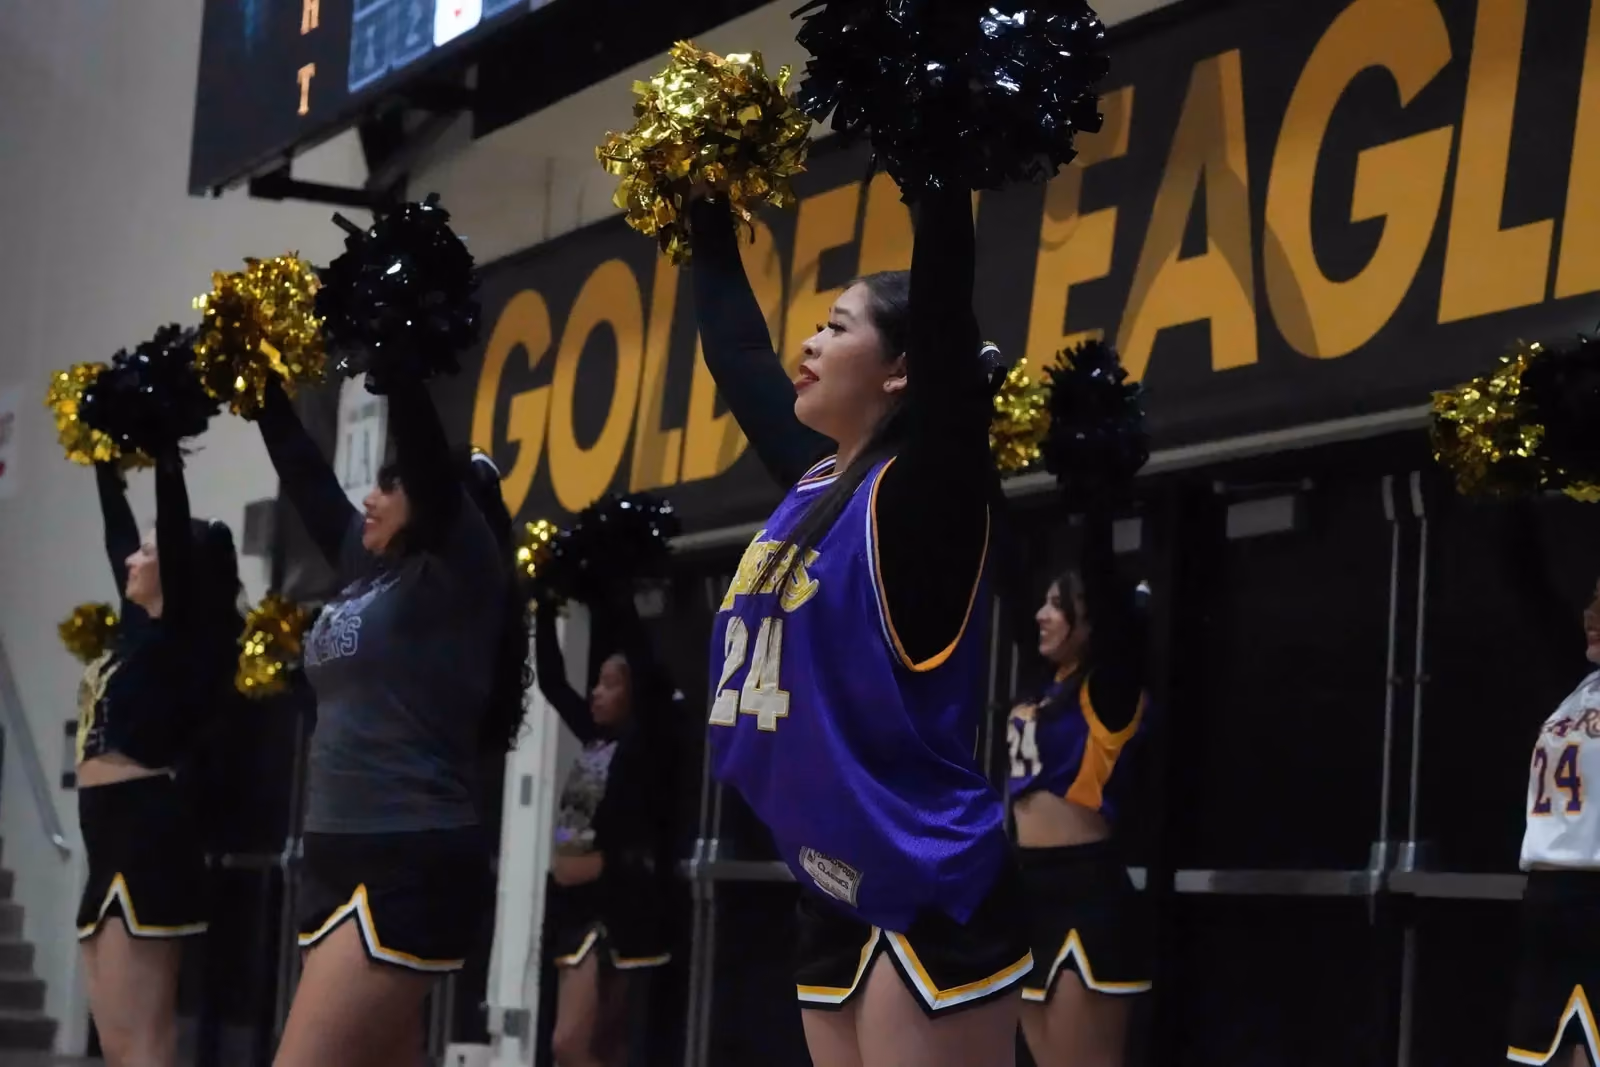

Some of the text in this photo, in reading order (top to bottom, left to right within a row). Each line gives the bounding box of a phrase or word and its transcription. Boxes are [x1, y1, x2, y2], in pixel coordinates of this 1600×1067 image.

[466, 170, 979, 519] GOLDE
[708, 615, 790, 731] 24
[1532, 742, 1583, 816] 24
